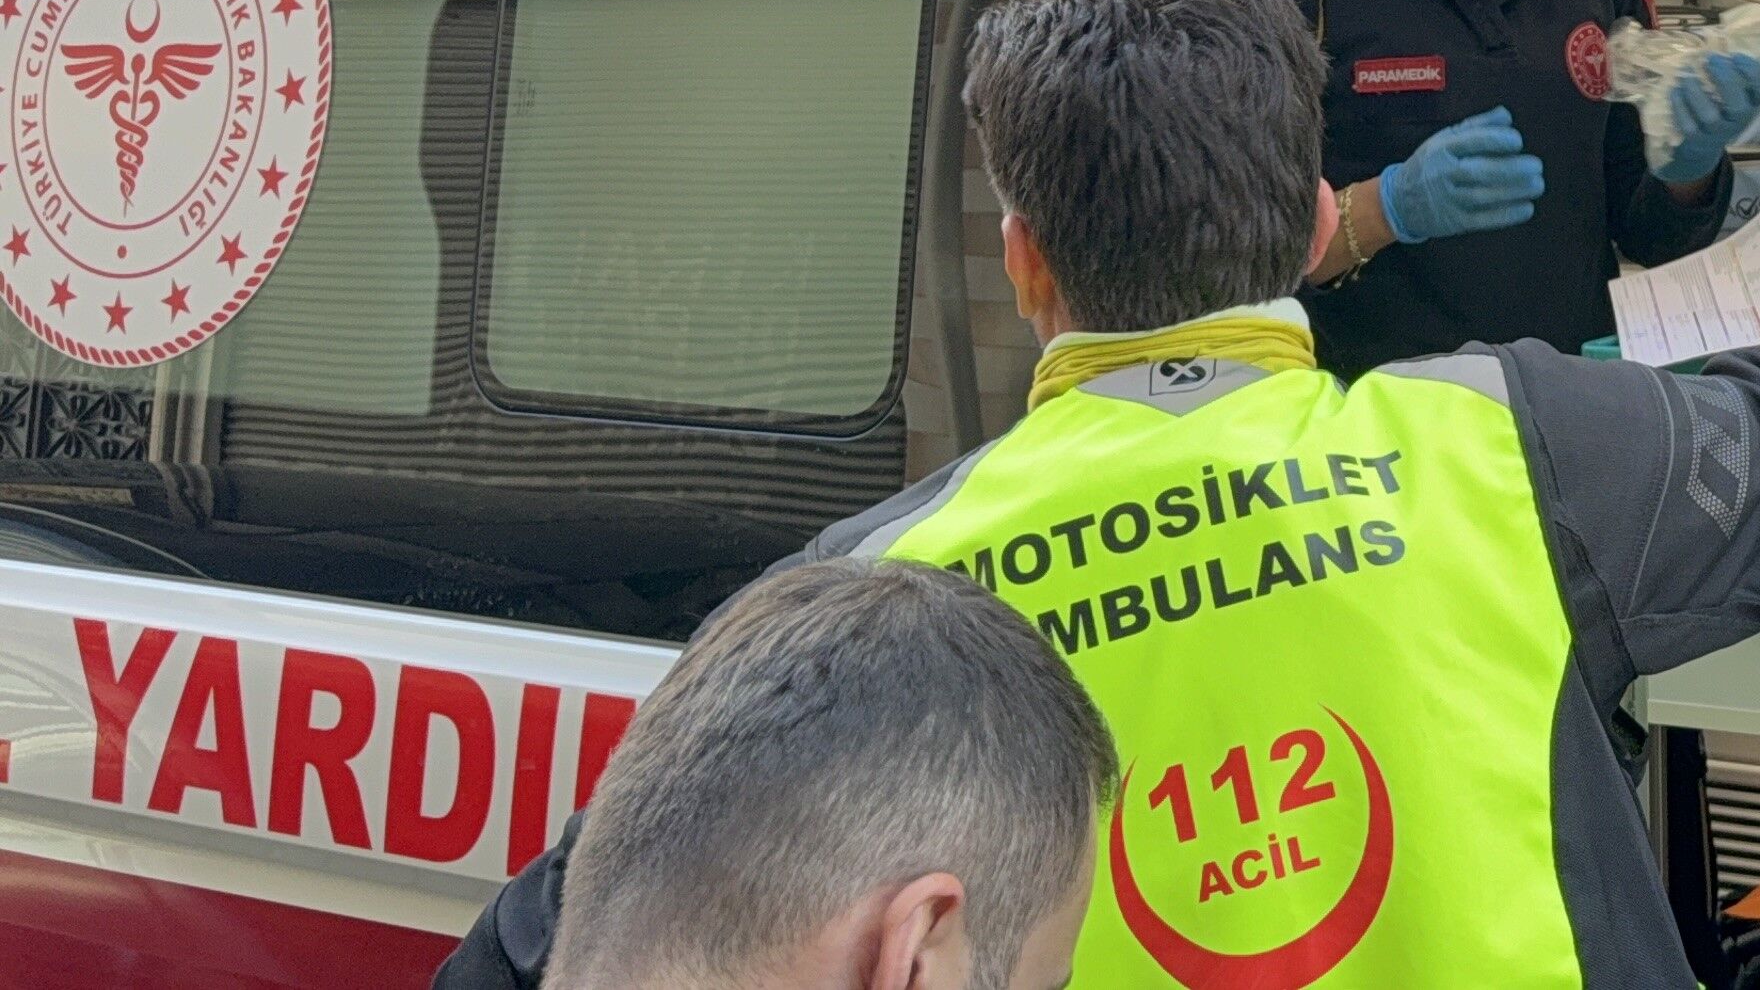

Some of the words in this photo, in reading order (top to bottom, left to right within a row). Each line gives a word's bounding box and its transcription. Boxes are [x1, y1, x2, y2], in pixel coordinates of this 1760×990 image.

[1359, 65, 1441, 83] PARAMEDİK
[21, 93, 73, 236] TÜRKİYE
[178, 40, 256, 237] BAKANLIĞI
[1036, 520, 1406, 656] MBULANS
[1147, 728, 1337, 843] 112
[1198, 832, 1322, 904] ACİL
